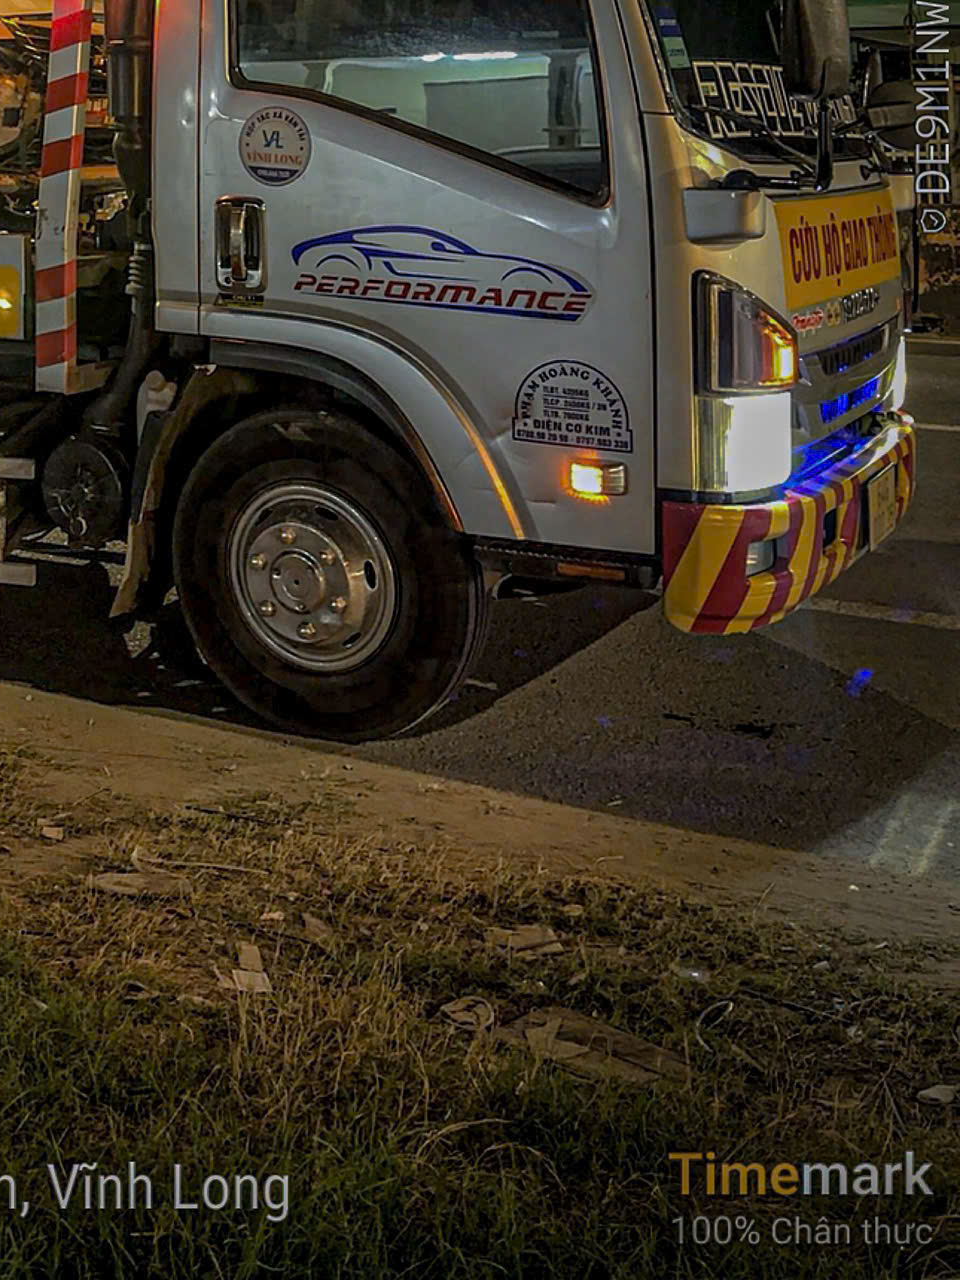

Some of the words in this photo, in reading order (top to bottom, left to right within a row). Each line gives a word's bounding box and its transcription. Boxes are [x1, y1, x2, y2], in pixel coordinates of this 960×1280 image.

[788, 215, 821, 285] CỨU
[821, 211, 842, 288] HỘ
[293, 272, 593, 312] PERFORMANCE
[539, 364, 591, 383] HOÀNG
[592, 377, 623, 430] KHÁNH
[585, 425, 611, 437] KIM
